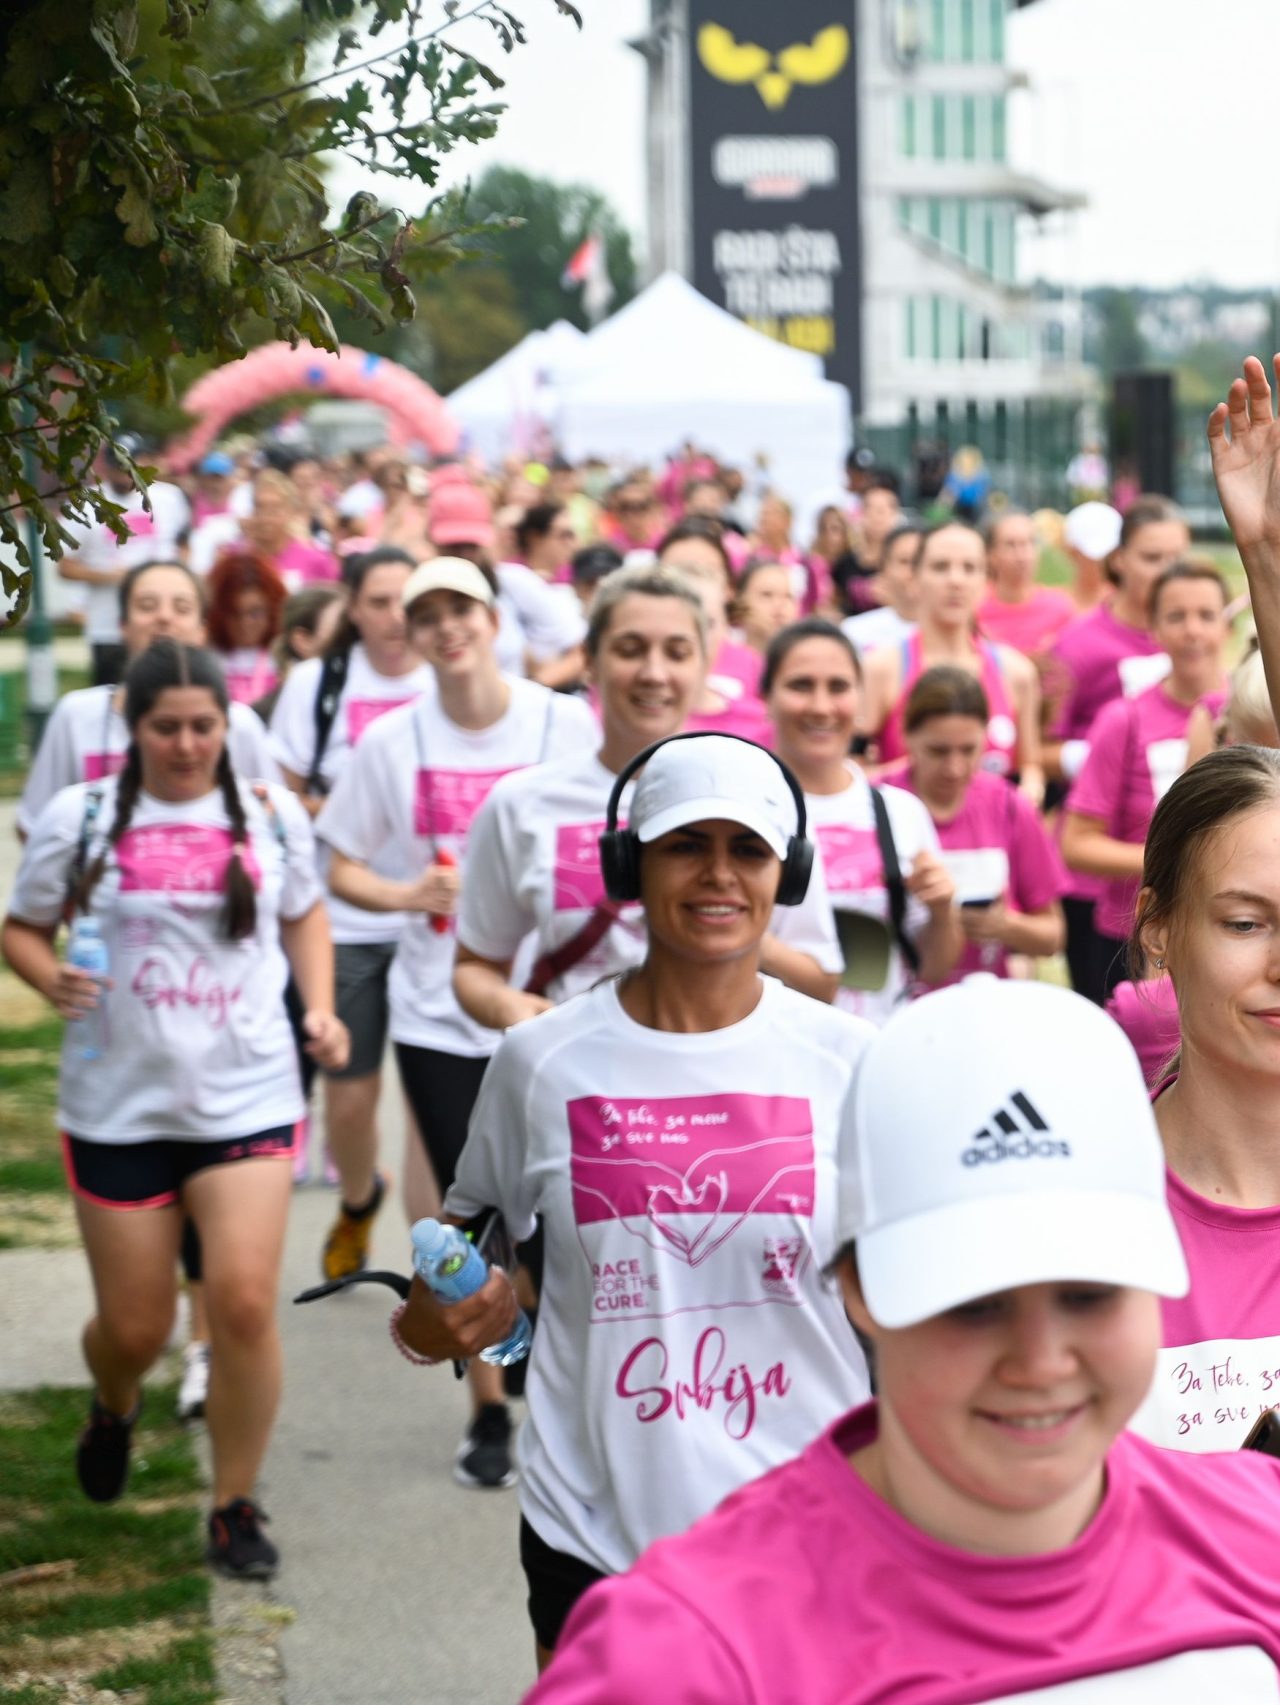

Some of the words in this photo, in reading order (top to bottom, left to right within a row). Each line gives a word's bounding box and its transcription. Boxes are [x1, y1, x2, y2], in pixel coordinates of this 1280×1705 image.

[592, 1258, 641, 1278] RACE
[592, 1276, 627, 1296] FOR
[628, 1273, 660, 1292] THE
[614, 1325, 793, 1440] Srbija
[1176, 1411, 1203, 1435] za
[1214, 1406, 1249, 1424] sve
